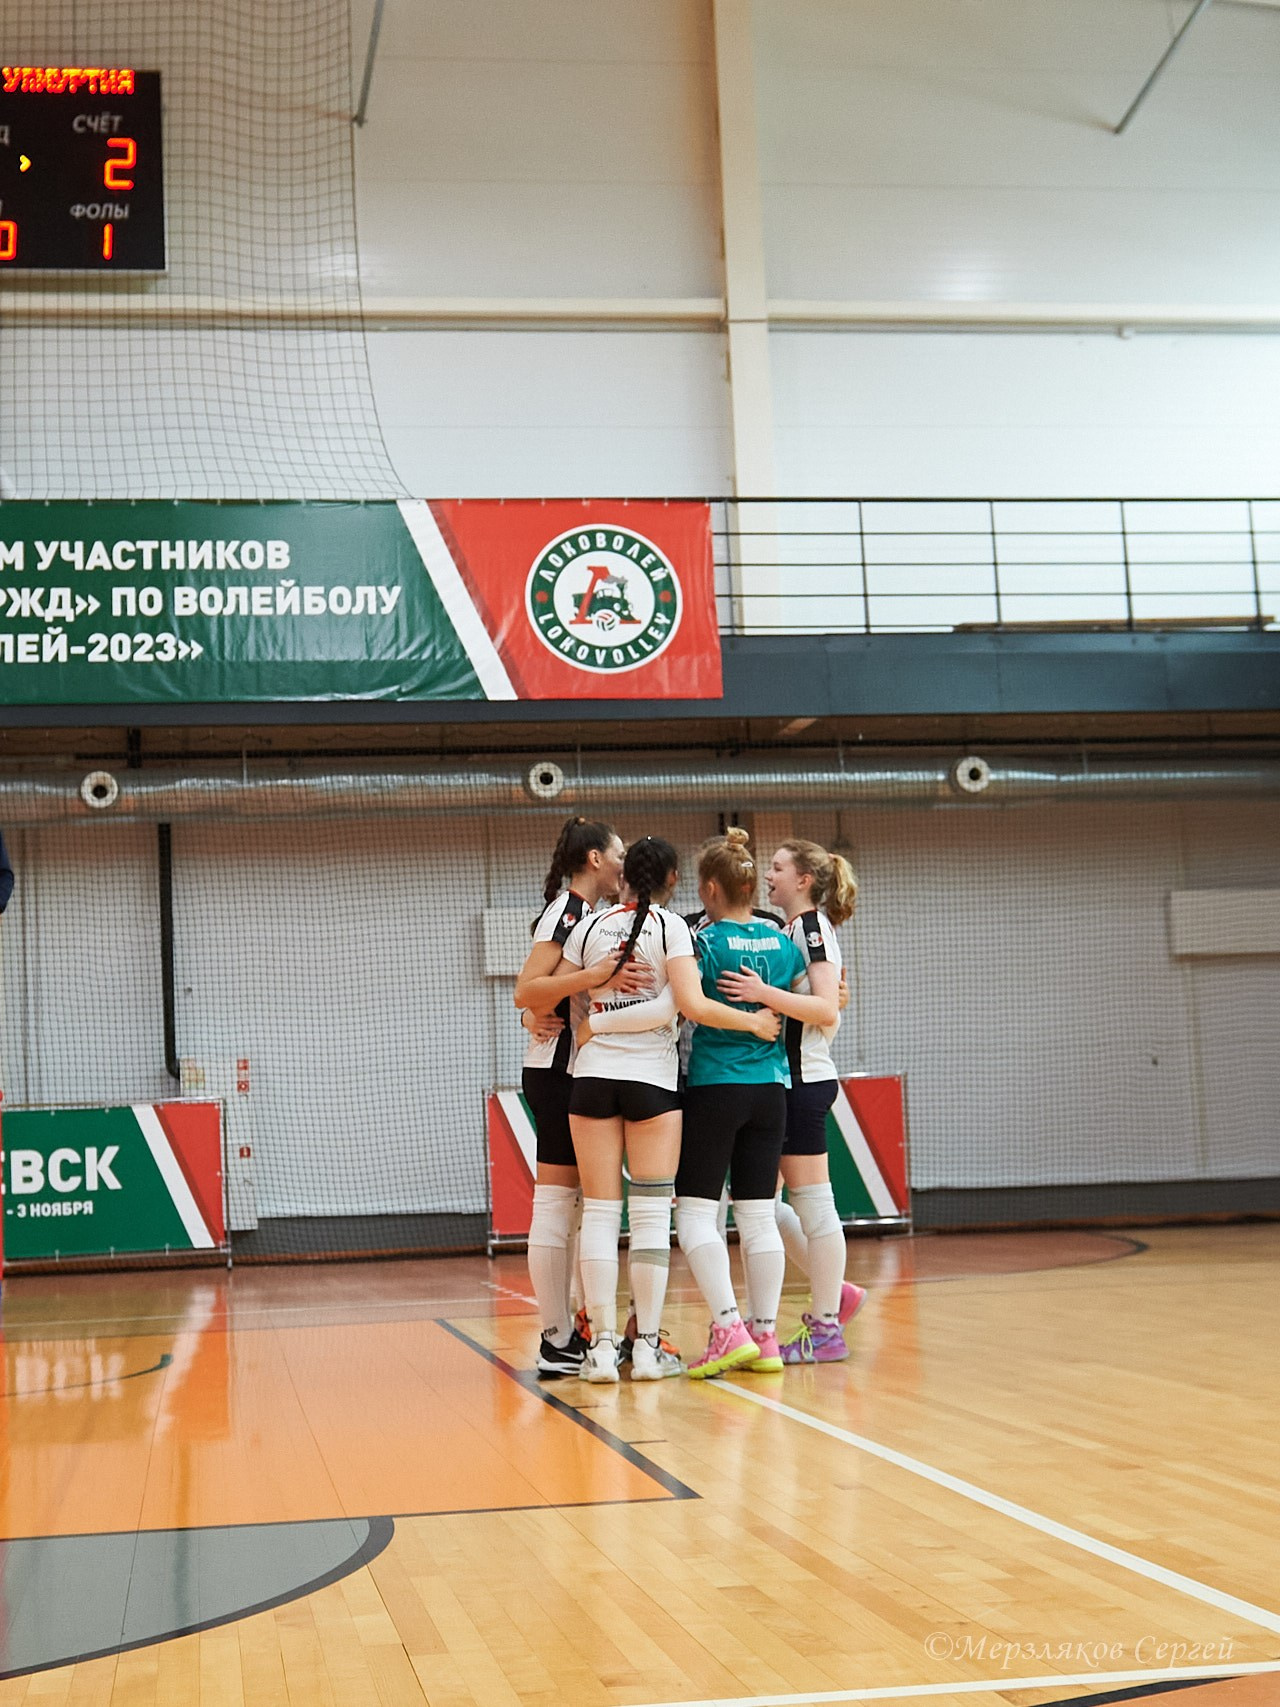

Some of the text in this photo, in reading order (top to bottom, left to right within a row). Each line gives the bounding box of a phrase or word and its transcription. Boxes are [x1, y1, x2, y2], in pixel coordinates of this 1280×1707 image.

[72, 113, 123, 134] СЧЁТ
[103, 137, 138, 191] 2
[69, 203, 130, 220] ФОЛЫ
[102, 223, 113, 260] 1
[35, 540, 291, 571] УЧАСТНИКОВ
[538, 532, 670, 583] ЛОКОВОЛЕЙ
[112, 587, 164, 618] ПО
[174, 581, 402, 617] ВОЛЕЙБОЛУ
[538, 612, 672, 664] LOKOVOLLEY
[30, 1201, 94, 1217] НОЯБРЯ
